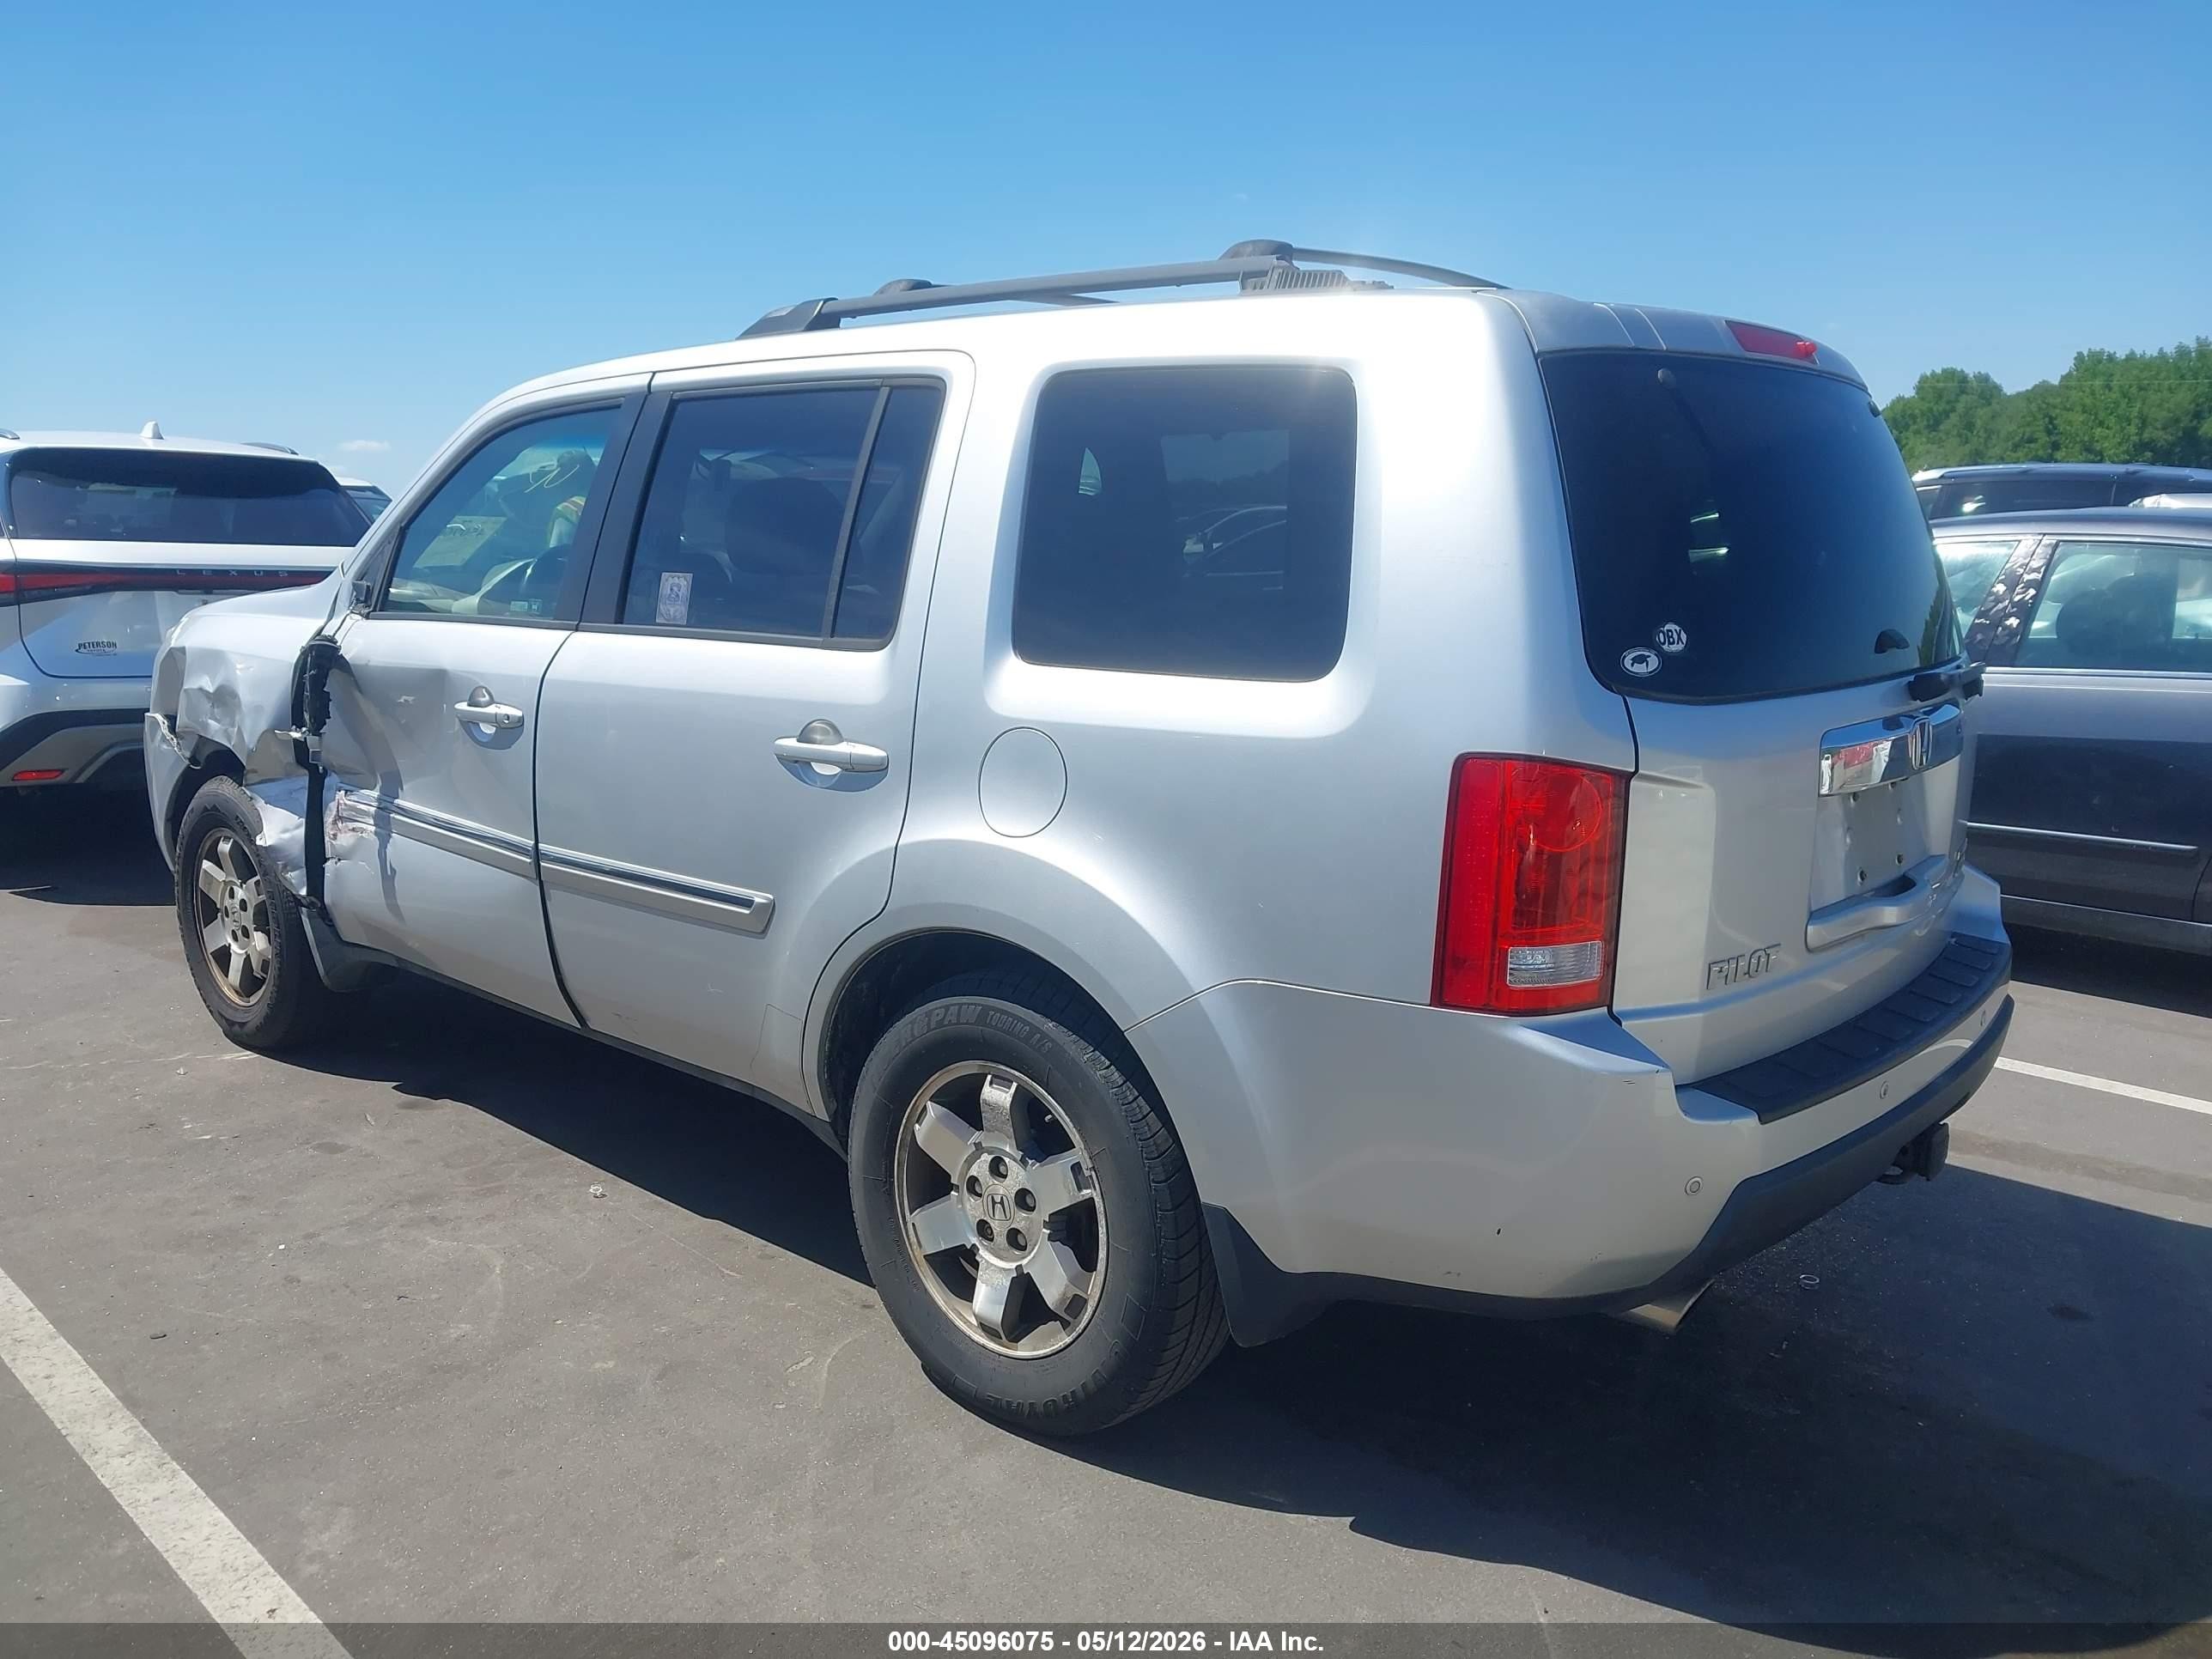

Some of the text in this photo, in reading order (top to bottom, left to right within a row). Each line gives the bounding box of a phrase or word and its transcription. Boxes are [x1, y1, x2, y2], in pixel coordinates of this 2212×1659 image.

[176, 568, 289, 577] LEXUS
[77, 640, 118, 650] PETERSON
[1657, 628, 1685, 647] OBX
[1705, 943, 1782, 990] PILOT
[987, 1010, 1031, 1039] TOURING
